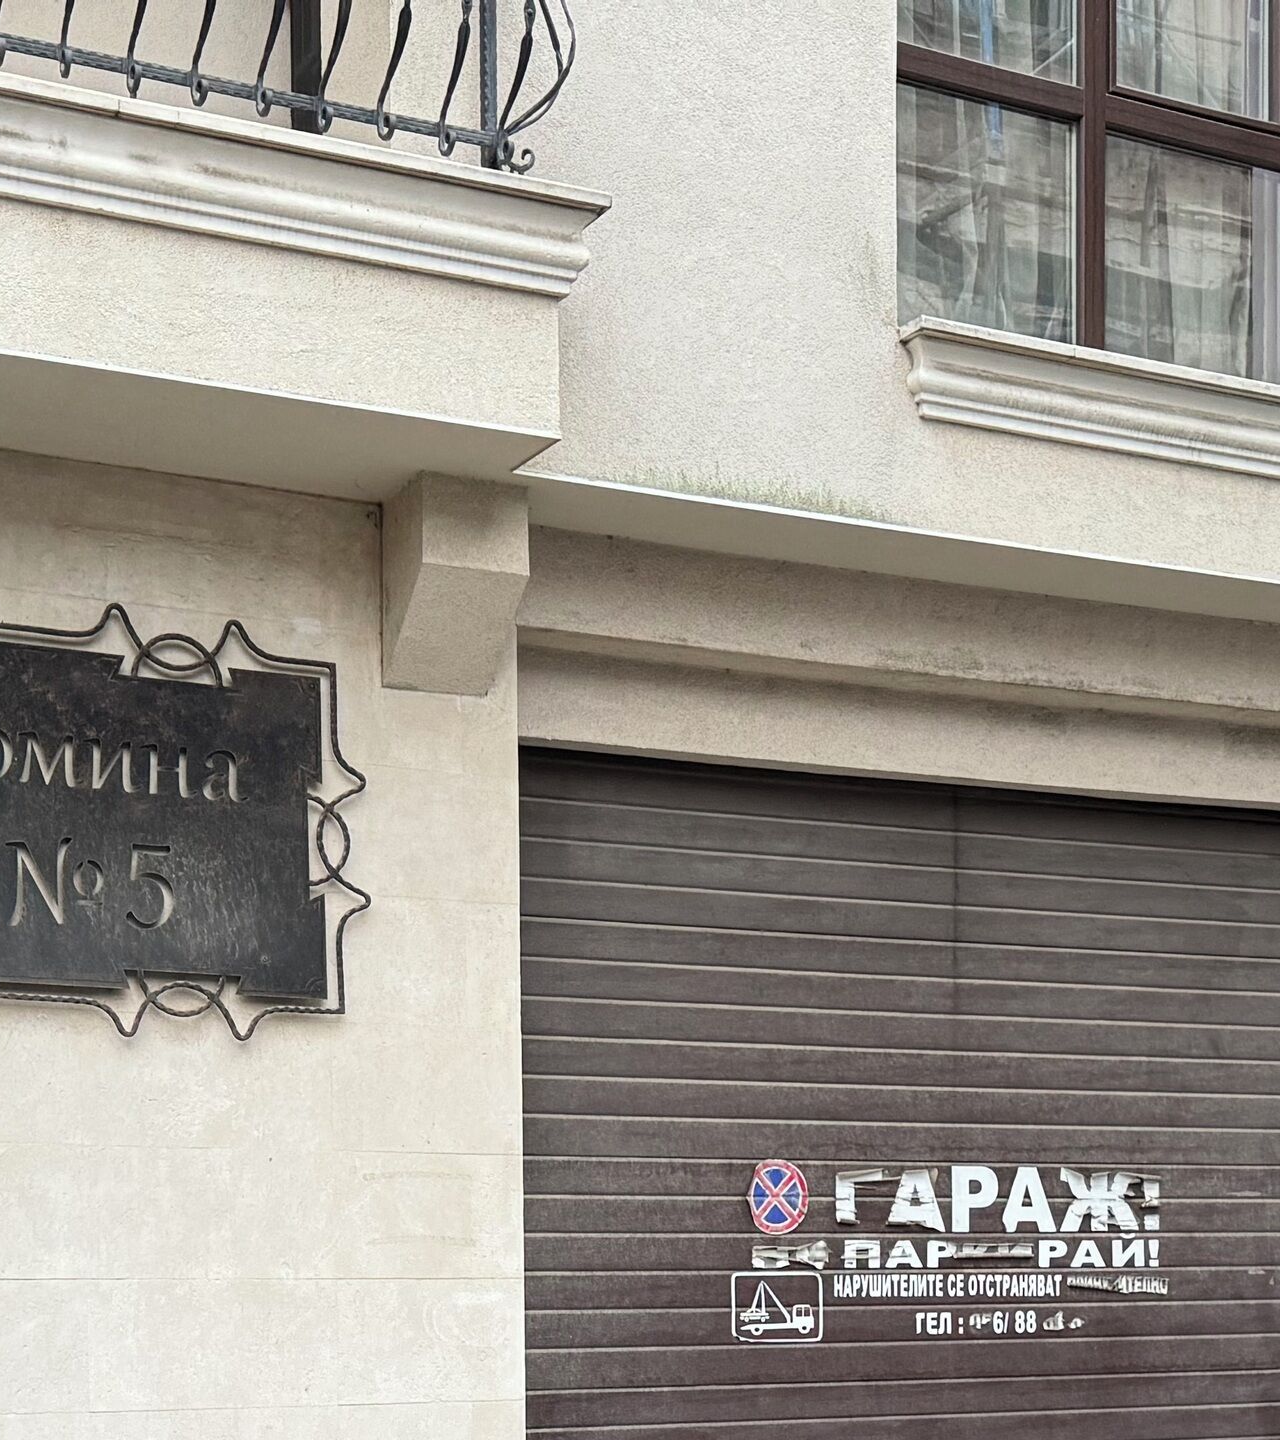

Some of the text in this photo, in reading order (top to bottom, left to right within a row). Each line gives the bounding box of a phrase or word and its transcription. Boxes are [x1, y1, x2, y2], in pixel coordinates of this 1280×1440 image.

[126, 844, 175, 930] 5
[835, 1166, 1160, 1233] ГАРАЖ!
[834, 1273, 944, 1298] НАРУШИТЕЛИТЕ
[947, 1273, 965, 1298] СЕ
[967, 1273, 1062, 1298] ОТСТРАНЯВАТ
